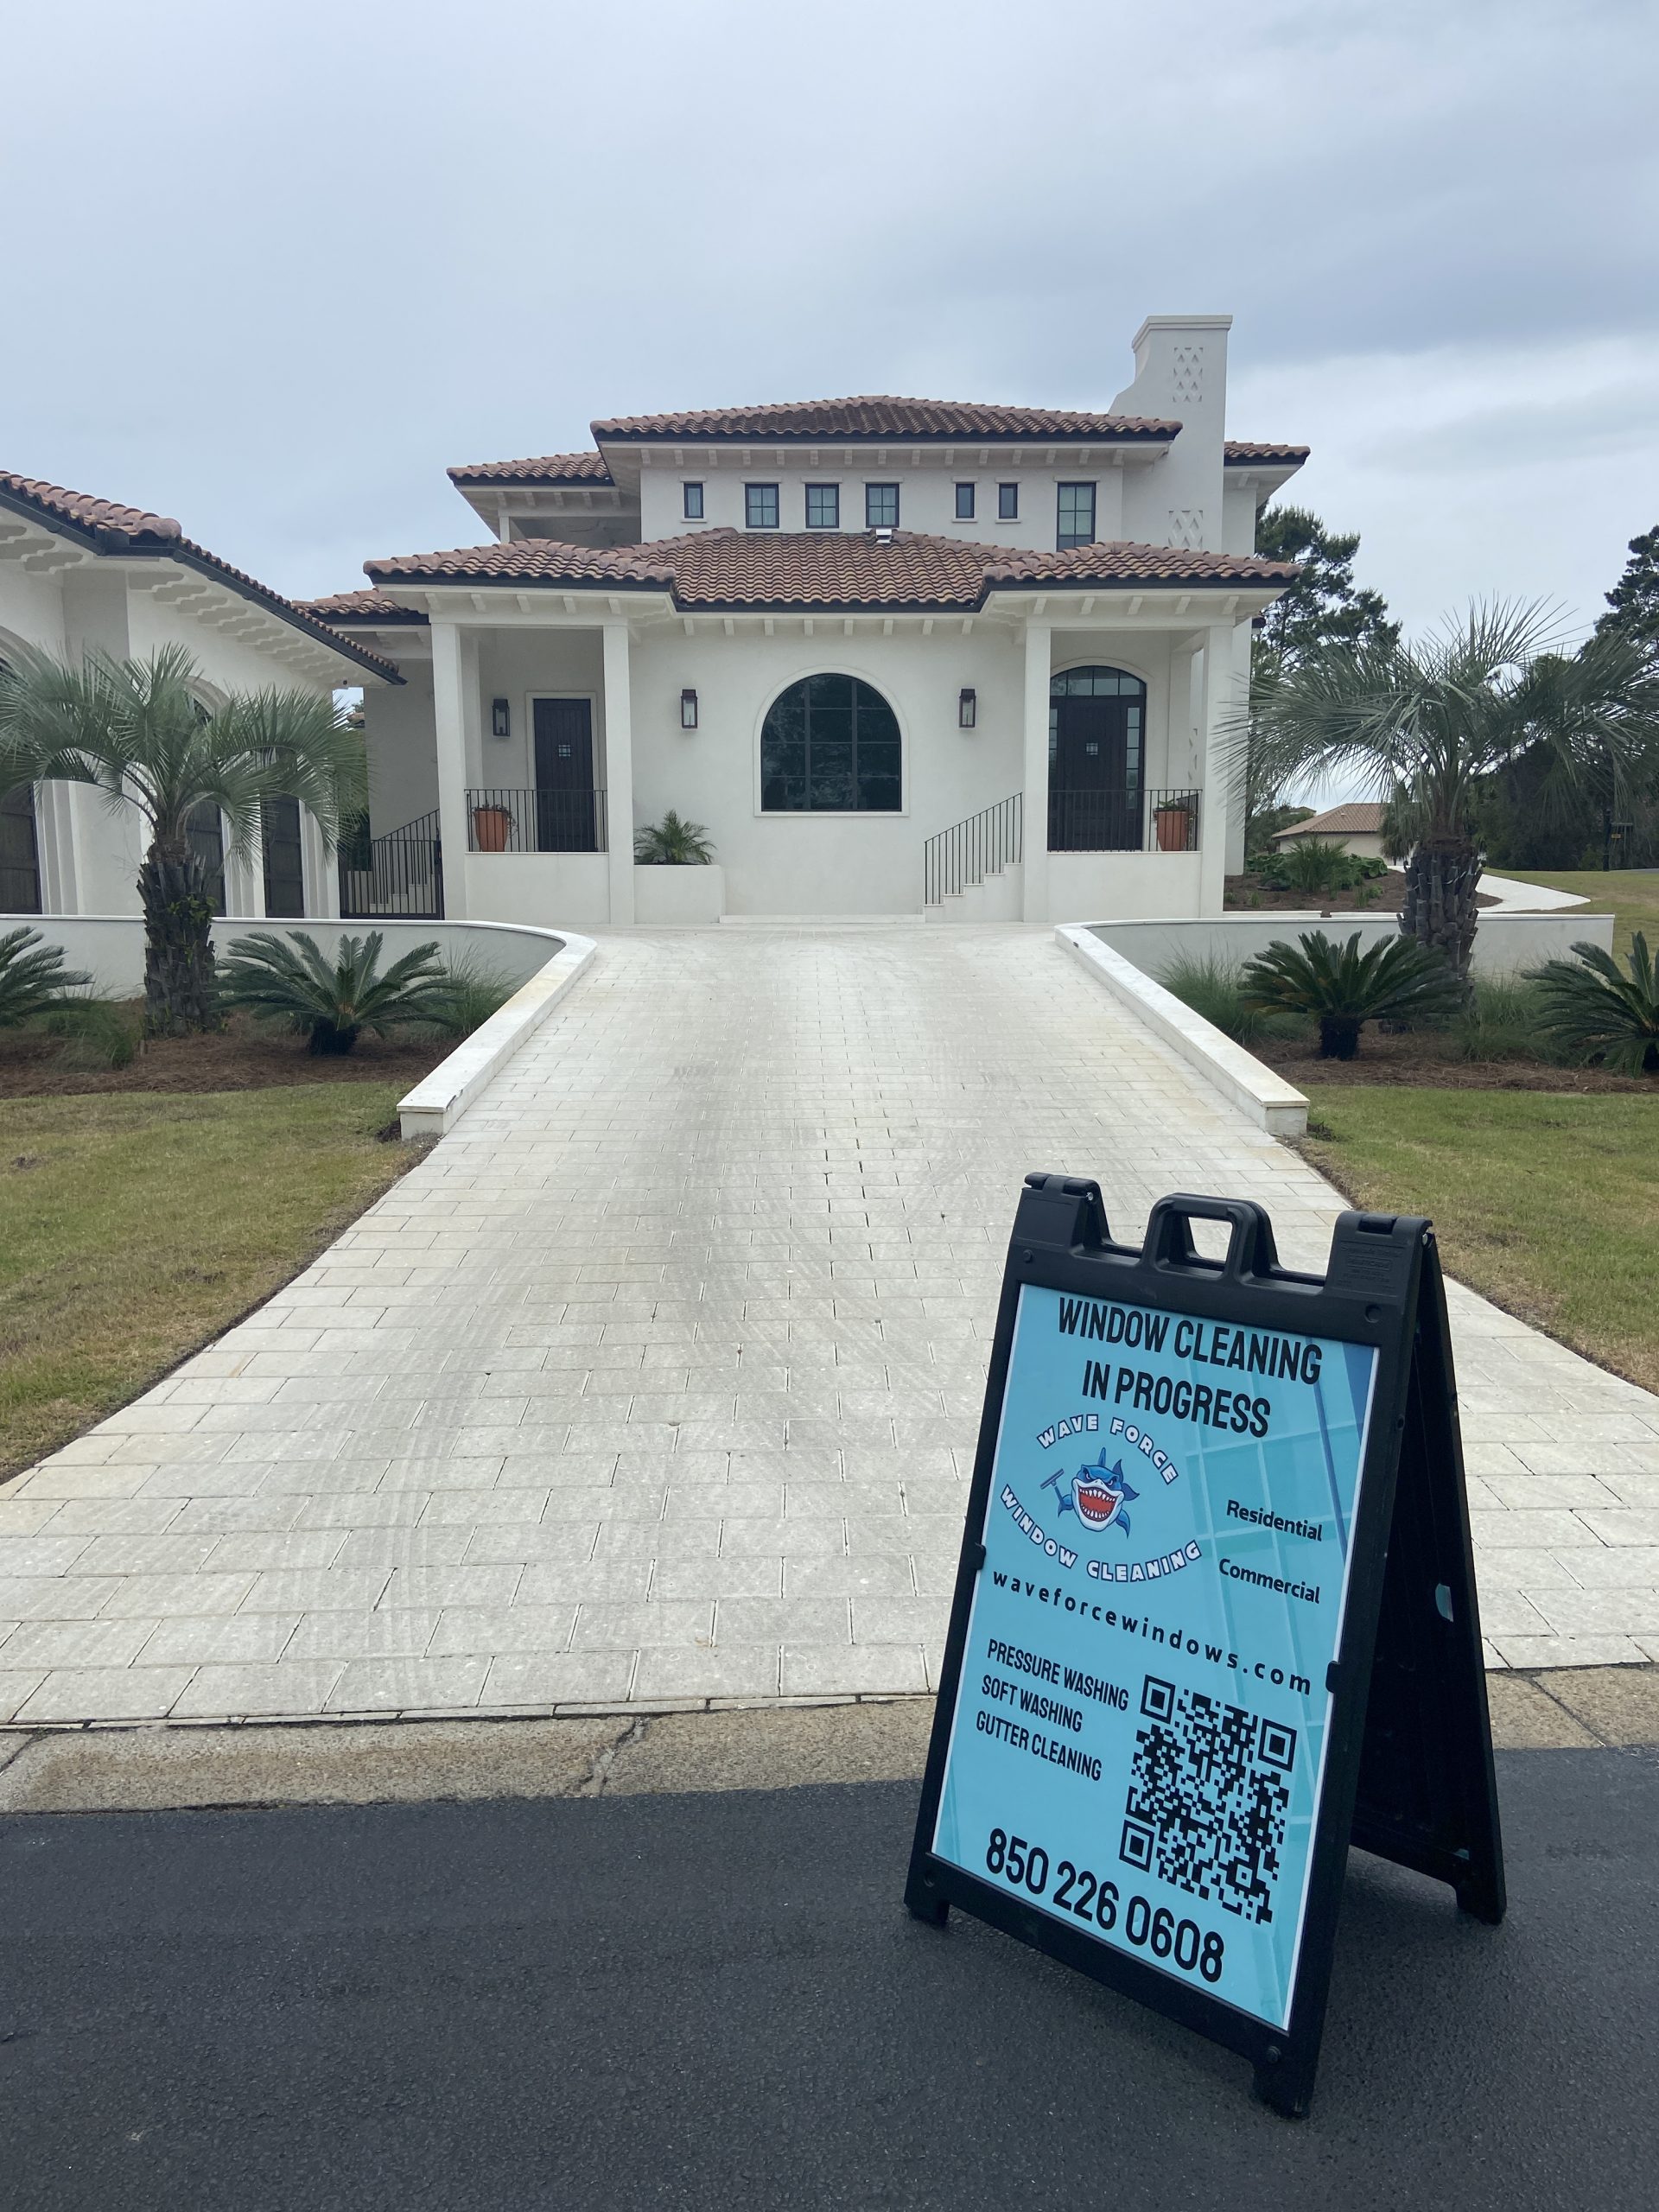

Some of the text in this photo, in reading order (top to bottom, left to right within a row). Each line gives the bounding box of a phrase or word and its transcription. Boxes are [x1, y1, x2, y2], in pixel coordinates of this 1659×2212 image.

[1058, 1296, 1323, 1385] WINDOW CLEANING
[1082, 1359, 1271, 1439] IN PROGRESS
[1037, 1414, 1179, 1485] WAVE FORCE
[1000, 1484, 1203, 1583] WINDOW CLEANING
[1226, 1499, 1323, 1542] Residential
[1218, 1558, 1320, 1605] Commercial
[993, 1571, 1311, 1696] waveforcewindows.com
[982, 1674, 1083, 1733] SOFT WASHING
[987, 1638, 1129, 1712] PRESSURE WASHING
[976, 1710, 1103, 1782] GUTTER CLEANING
[986, 1827, 1224, 1983] 850 226 0608
